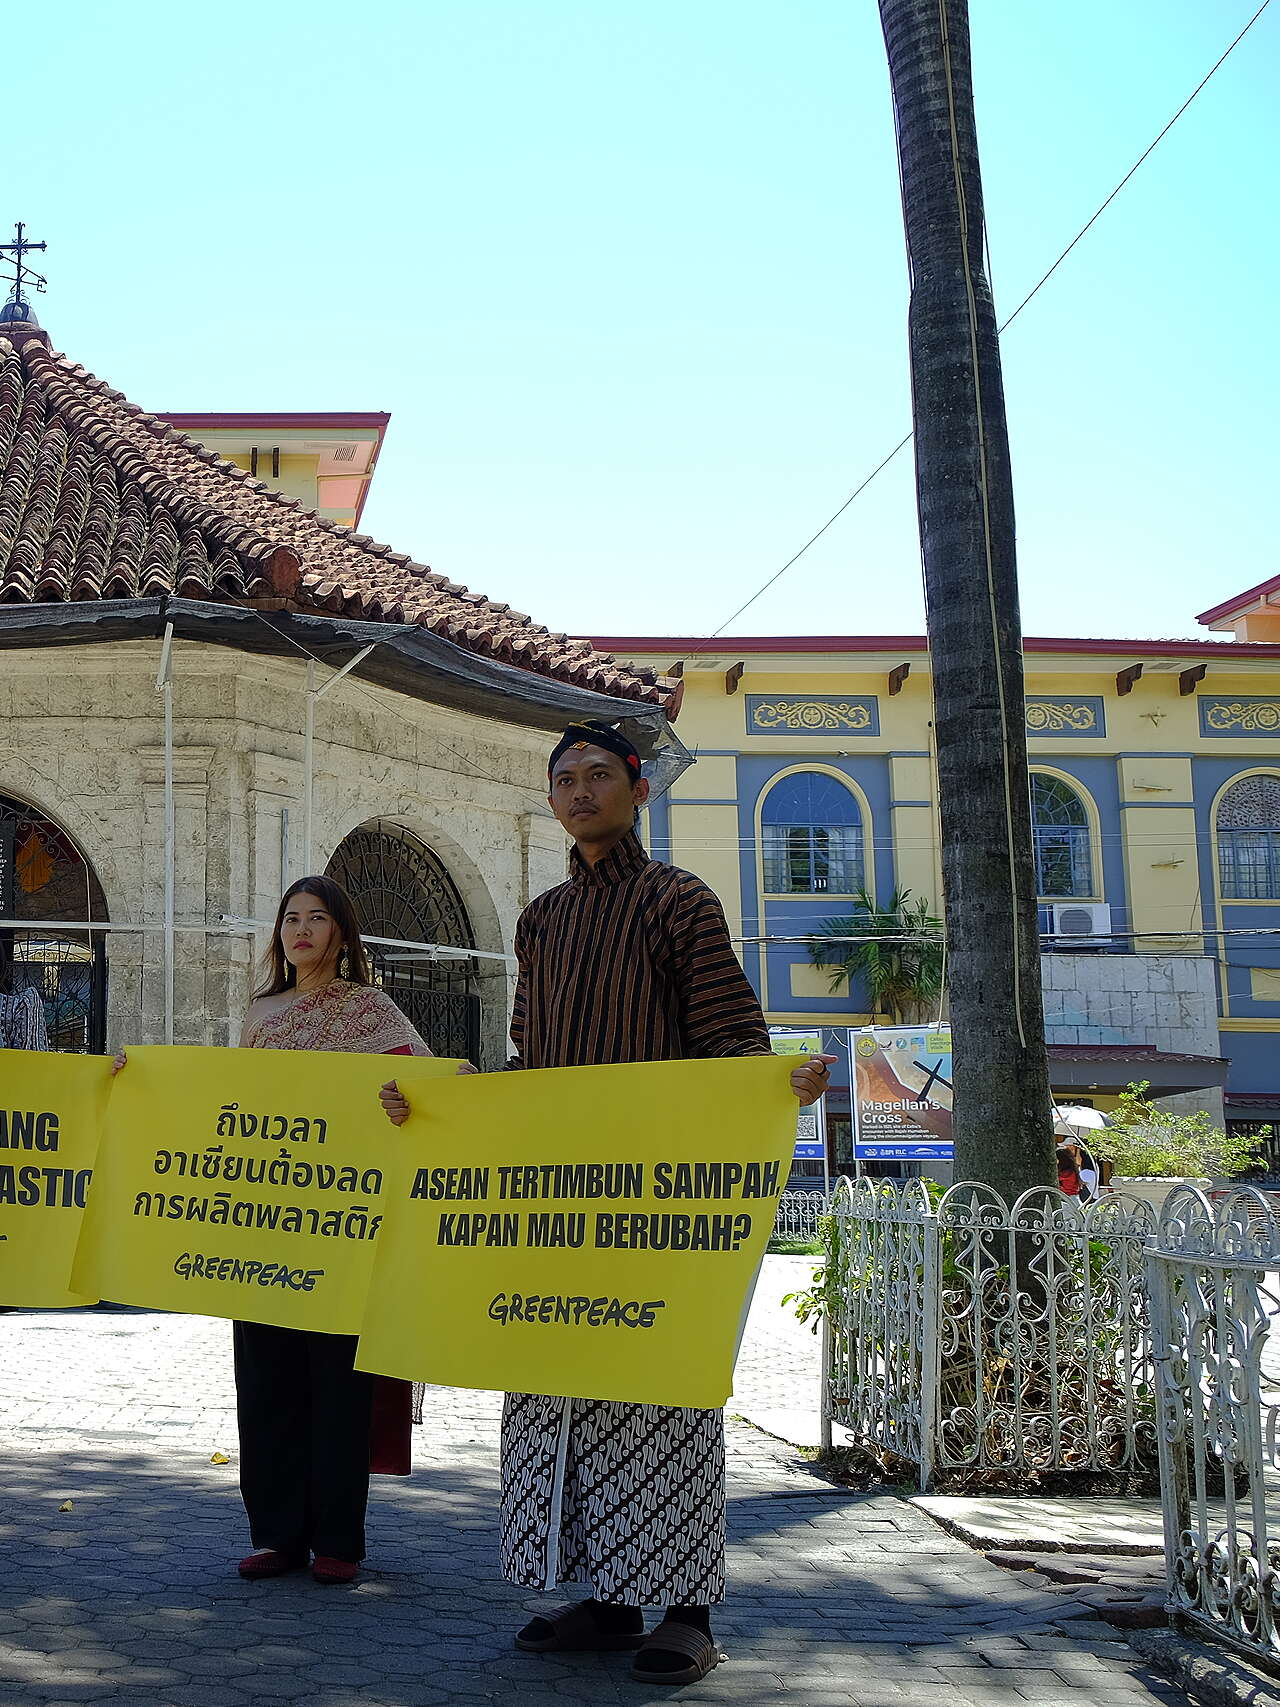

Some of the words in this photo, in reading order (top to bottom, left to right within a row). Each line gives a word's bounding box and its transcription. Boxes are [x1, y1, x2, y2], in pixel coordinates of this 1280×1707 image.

[799, 1041, 808, 1052] 4
[216, 1102, 327, 1144] ถึงเวลา
[862, 1099, 941, 1113] Magellan's
[862, 1112, 902, 1124] Cross
[153, 1145, 383, 1195] อาเซียนต้องลด
[409, 1167, 490, 1201] ASEAN
[497, 1162, 644, 1200] TERTIMBUN
[436, 1213, 519, 1247] KAPAN
[526, 1213, 586, 1249] MAU
[594, 1212, 752, 1252] BERUBAH?
[173, 1252, 325, 1292] GREENPEACE
[488, 1292, 666, 1329] GREENPEACE
